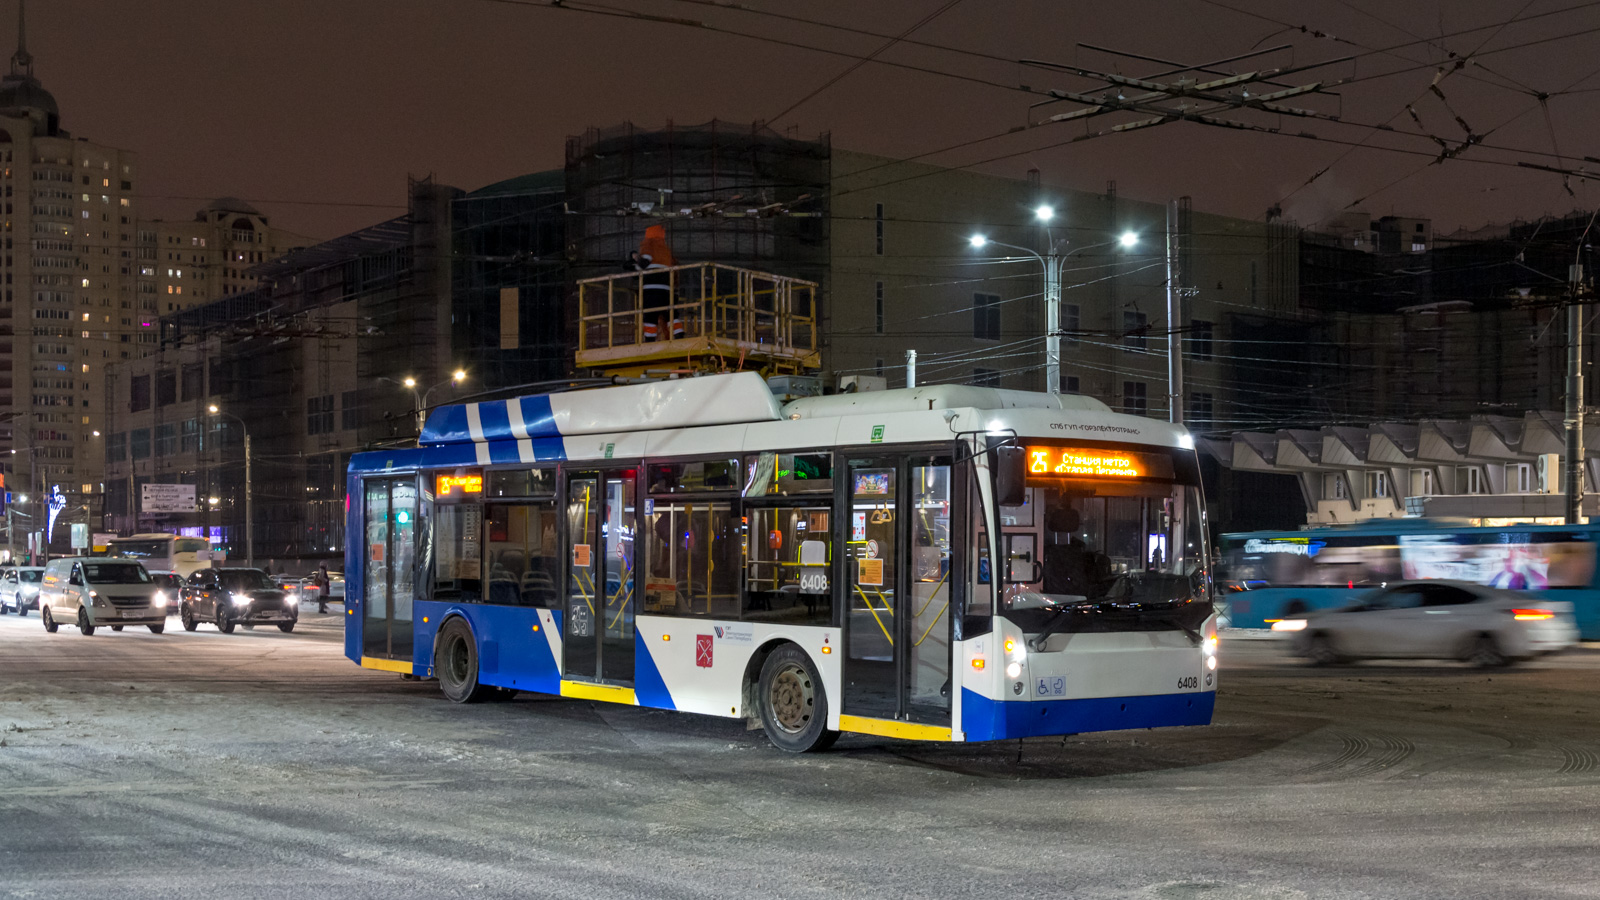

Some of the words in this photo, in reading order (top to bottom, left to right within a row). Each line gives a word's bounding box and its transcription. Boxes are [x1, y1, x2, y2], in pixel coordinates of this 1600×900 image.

[1078, 424, 1141, 435] «ГОРЭЛЕКТРОТРАНС»
[1031, 451, 1048, 473] 25
[1062, 453, 1101, 466] Станция
[1102, 457, 1130, 468] метро
[800, 574, 828, 591] 6408
[1177, 676, 1198, 689] 6408
